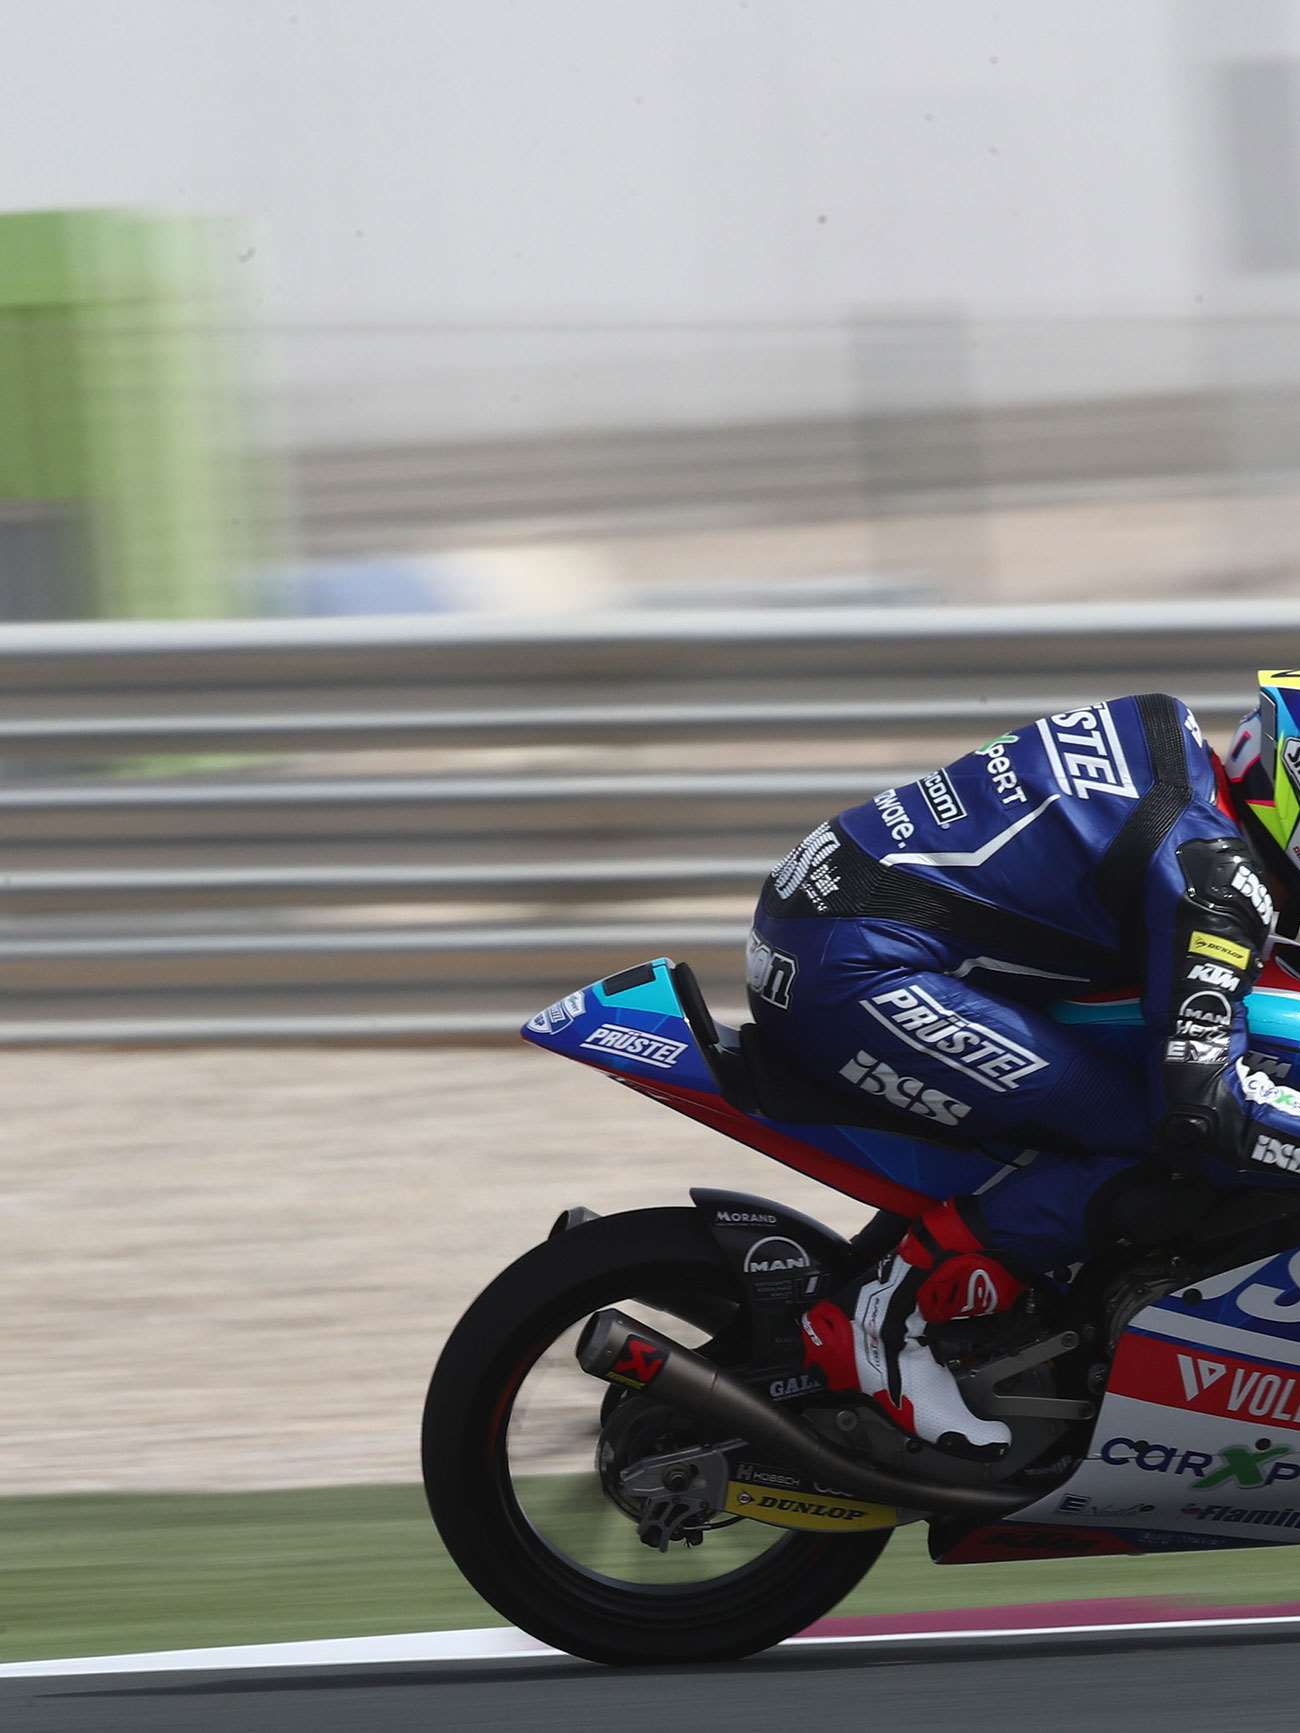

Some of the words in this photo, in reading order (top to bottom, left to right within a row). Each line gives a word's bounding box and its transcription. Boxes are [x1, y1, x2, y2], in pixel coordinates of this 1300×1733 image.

[1187, 963, 1241, 993] KTM
[1185, 1008, 1230, 1025] MAN
[587, 1030, 688, 1065] PRÜSTEL
[872, 988, 1050, 1089] PRÜSTEL
[716, 1210, 777, 1224] MORAND
[750, 1258, 804, 1272] MAN
[757, 1495, 868, 1521] DUNLOP
